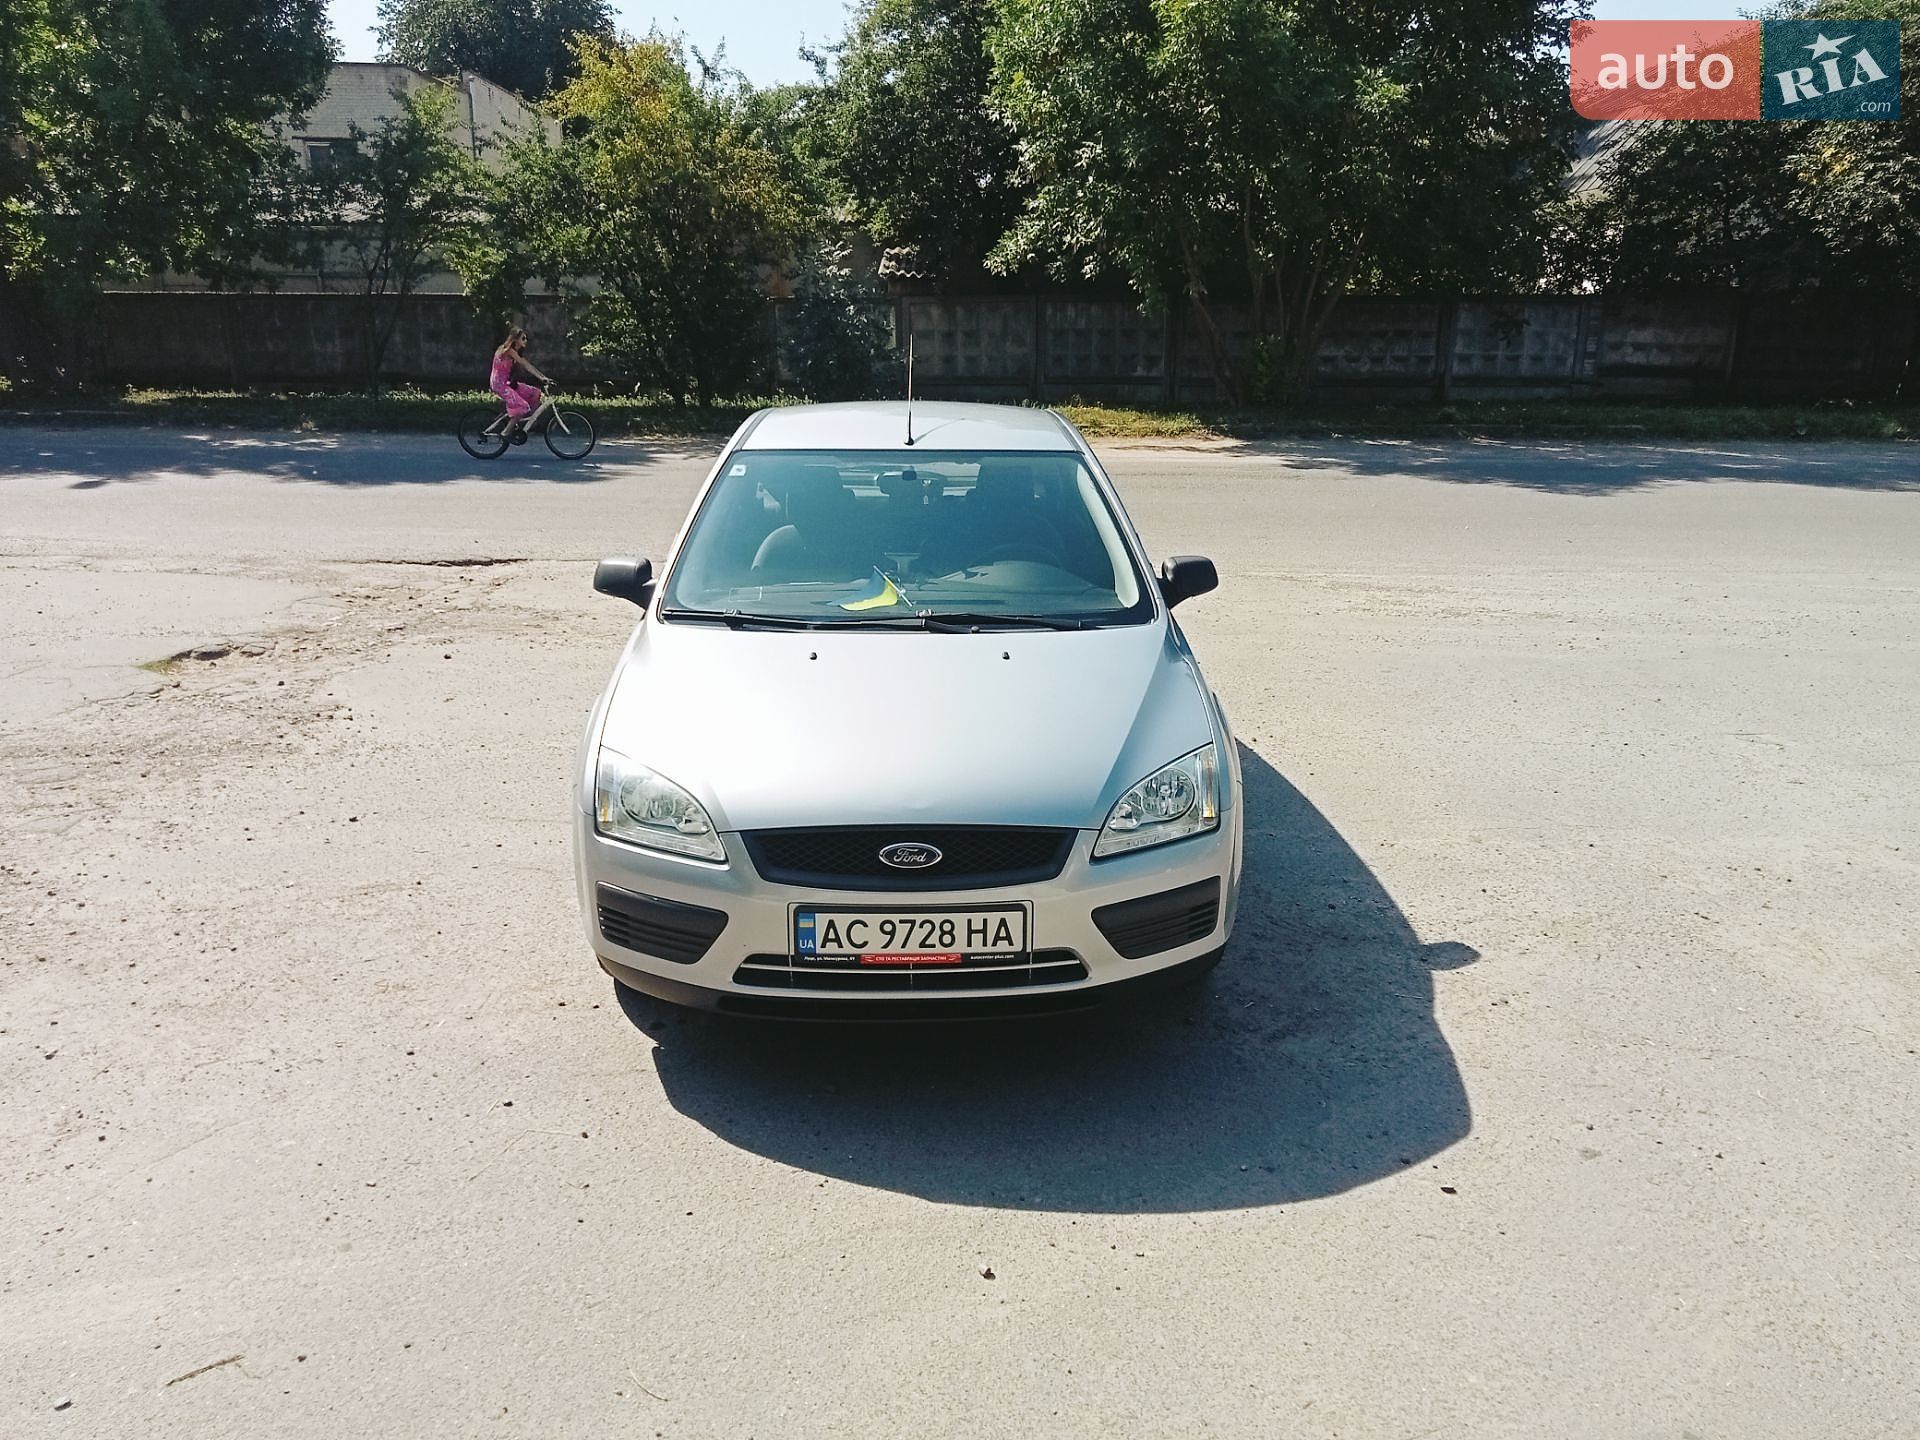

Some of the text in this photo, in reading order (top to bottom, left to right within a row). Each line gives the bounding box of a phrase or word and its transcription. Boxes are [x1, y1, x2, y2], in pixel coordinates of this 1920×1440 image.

[893, 848, 927, 862] Ford
[820, 917, 1014, 949] AC 9728 HA
[799, 940, 814, 949] UA
